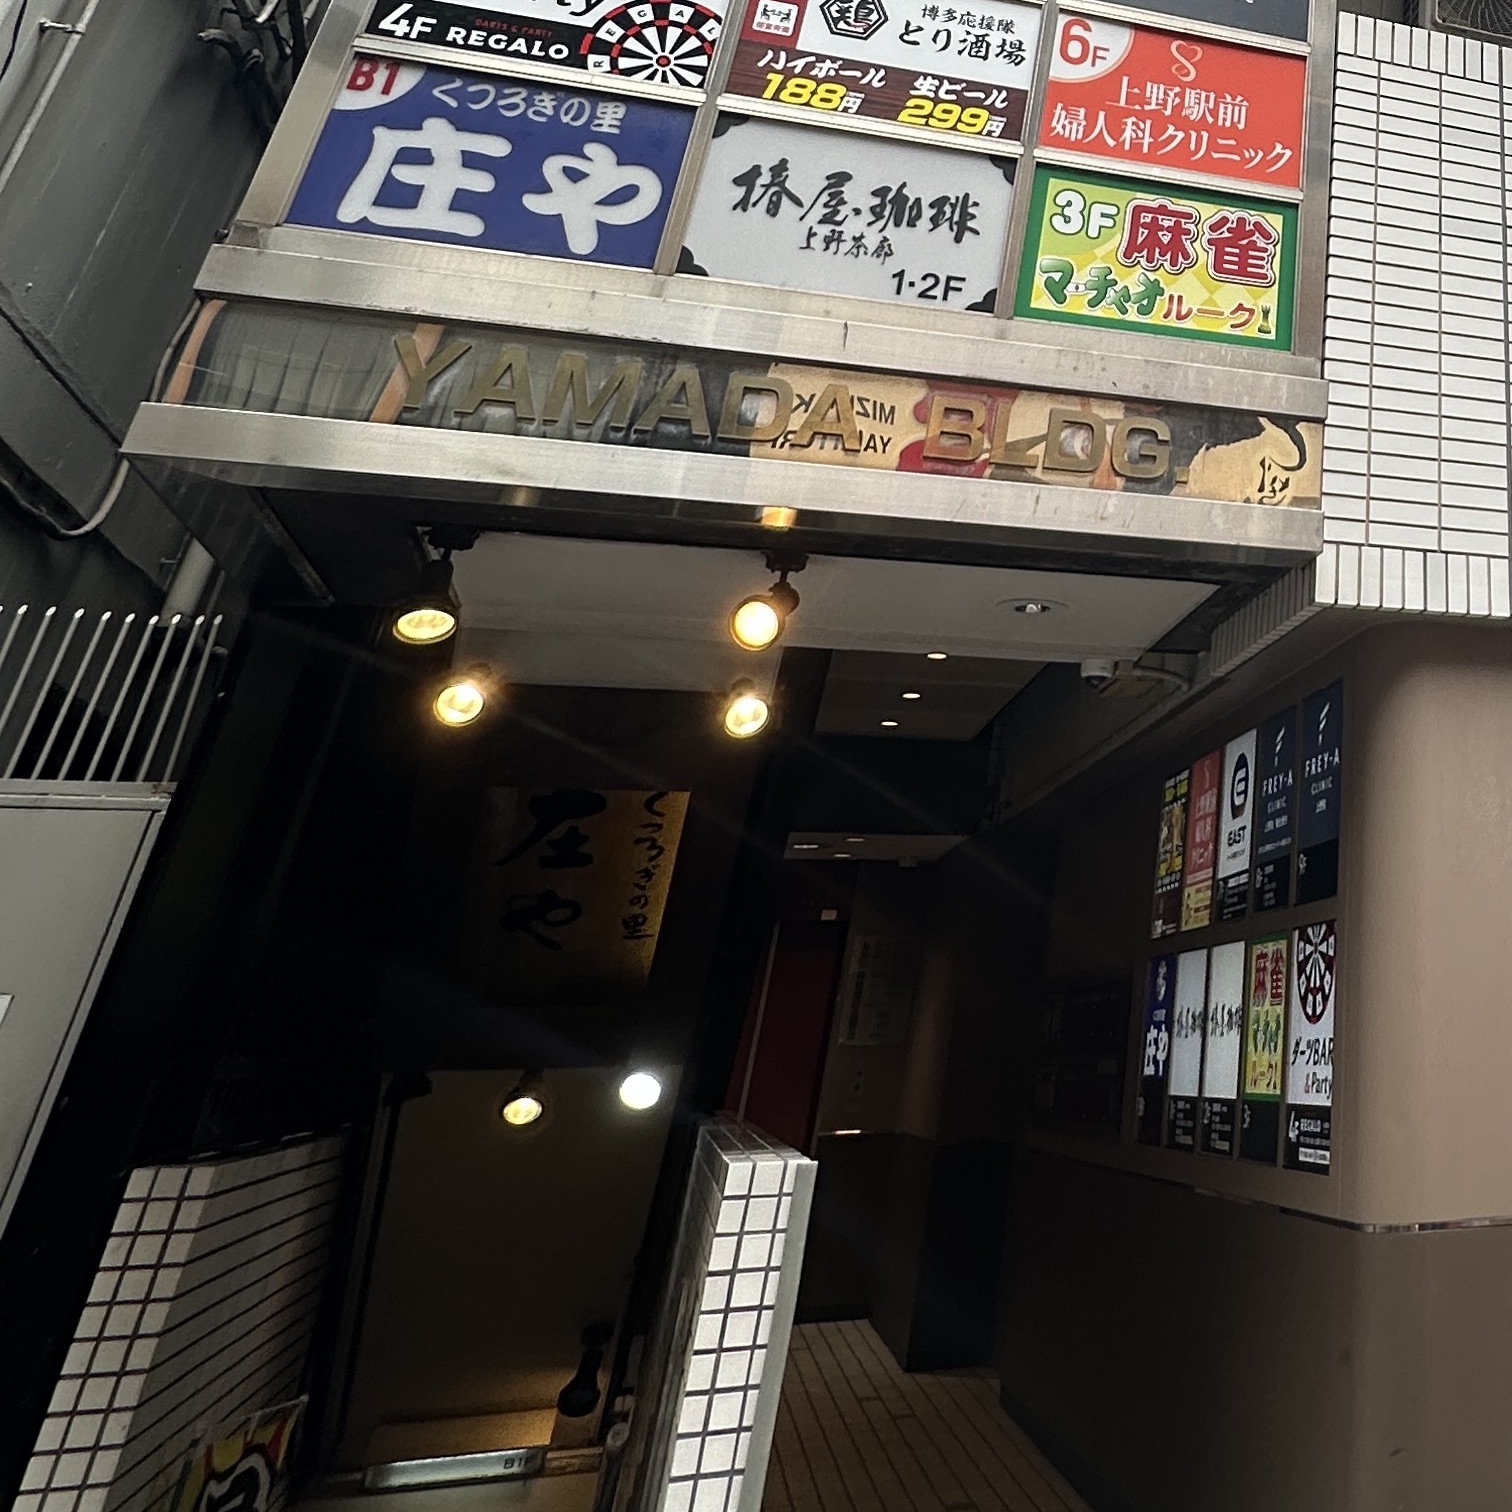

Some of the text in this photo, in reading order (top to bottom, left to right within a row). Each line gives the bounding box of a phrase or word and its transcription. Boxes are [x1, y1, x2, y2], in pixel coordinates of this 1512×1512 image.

[379, 2, 438, 40] 4F
[446, 26, 570, 60] REGALO
[921, 4, 1016, 35] 博多応援隊
[1059, 17, 1110, 67] 6F
[899, 20, 1027, 67] とり酒場
[346, 57, 401, 96] B1
[757, 49, 886, 88] ハイボール
[910, 75, 1008, 109] 生ビール
[432, 76, 627, 134] くつろぎの里
[762, 72, 865, 113] 188円
[1105, 75, 1250, 130] 上野駅前
[897, 98, 1007, 137] 299円
[1050, 102, 1293, 173] 婦人科クリニック
[336, 116, 663, 256] 庄や
[1051, 189, 1120, 239] 3F
[1119, 199, 1277, 285] 麻雀
[394, 334, 1189, 483] YAMADA BLDG.
